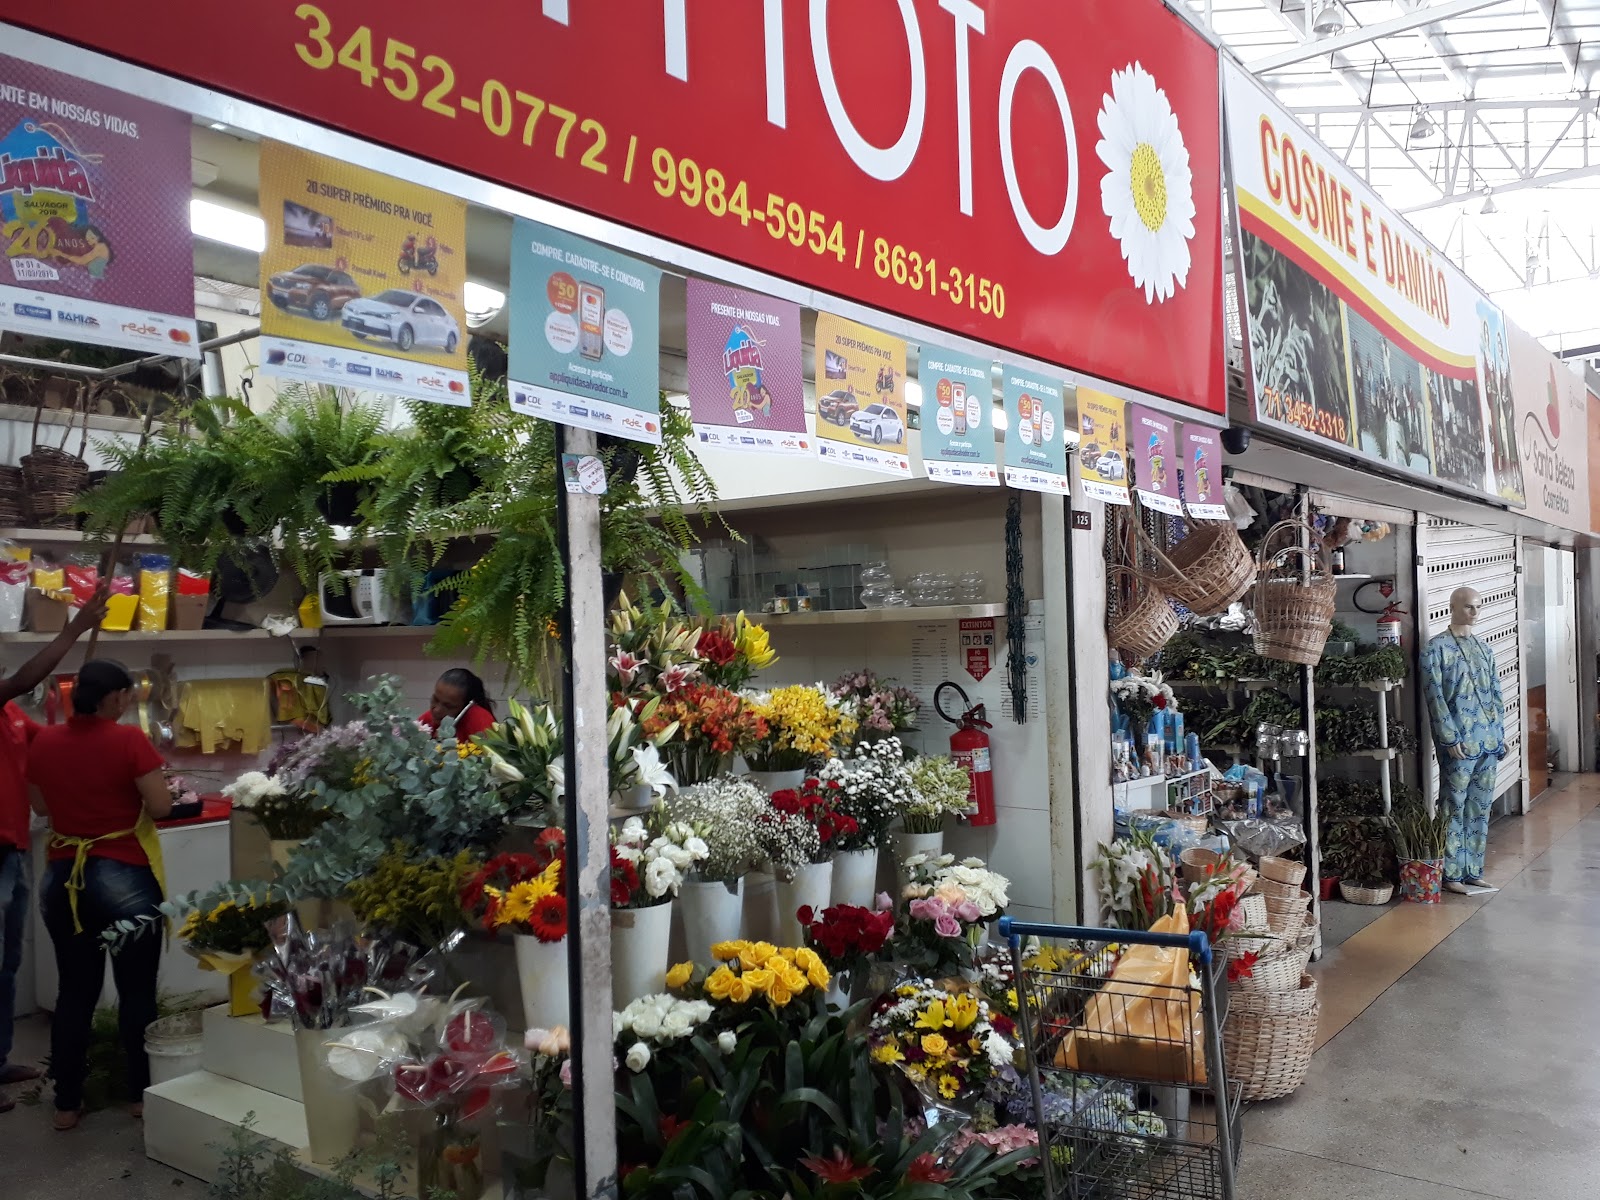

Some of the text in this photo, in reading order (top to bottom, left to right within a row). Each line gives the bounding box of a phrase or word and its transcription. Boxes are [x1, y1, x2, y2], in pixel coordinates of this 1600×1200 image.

[29, 92, 48, 112] EM
[52, 99, 100, 127] NOSSAS
[104, 114, 139, 139] VIDAS.
[294, 4, 608, 175] 3452-0772
[651, 147, 846, 263] 9984-5954
[873, 238, 1005, 319] 8631-3150
[306, 179, 317, 194] 20
[321, 183, 351, 204] SUPER
[353, 192, 392, 216] PRÊMIOS
[394, 205, 410, 221] PRA
[1258, 113, 1452, 330] COSME E DAMIÃO
[58, 238, 86, 249] ANOS
[565, 252, 610, 278] CADASTRE-SE
[611, 266, 616, 280] E
[711, 302, 736, 318] PRESENTE
[737, 308, 745, 319] EM
[745, 309, 766, 324] NOSSAS
[1263, 385, 1347, 443] 71 3452-3318
[1533, 440, 1553, 481] Santa
[1076, 514, 1089, 526] 125
[961, 620, 992, 629] EXTINTOR
